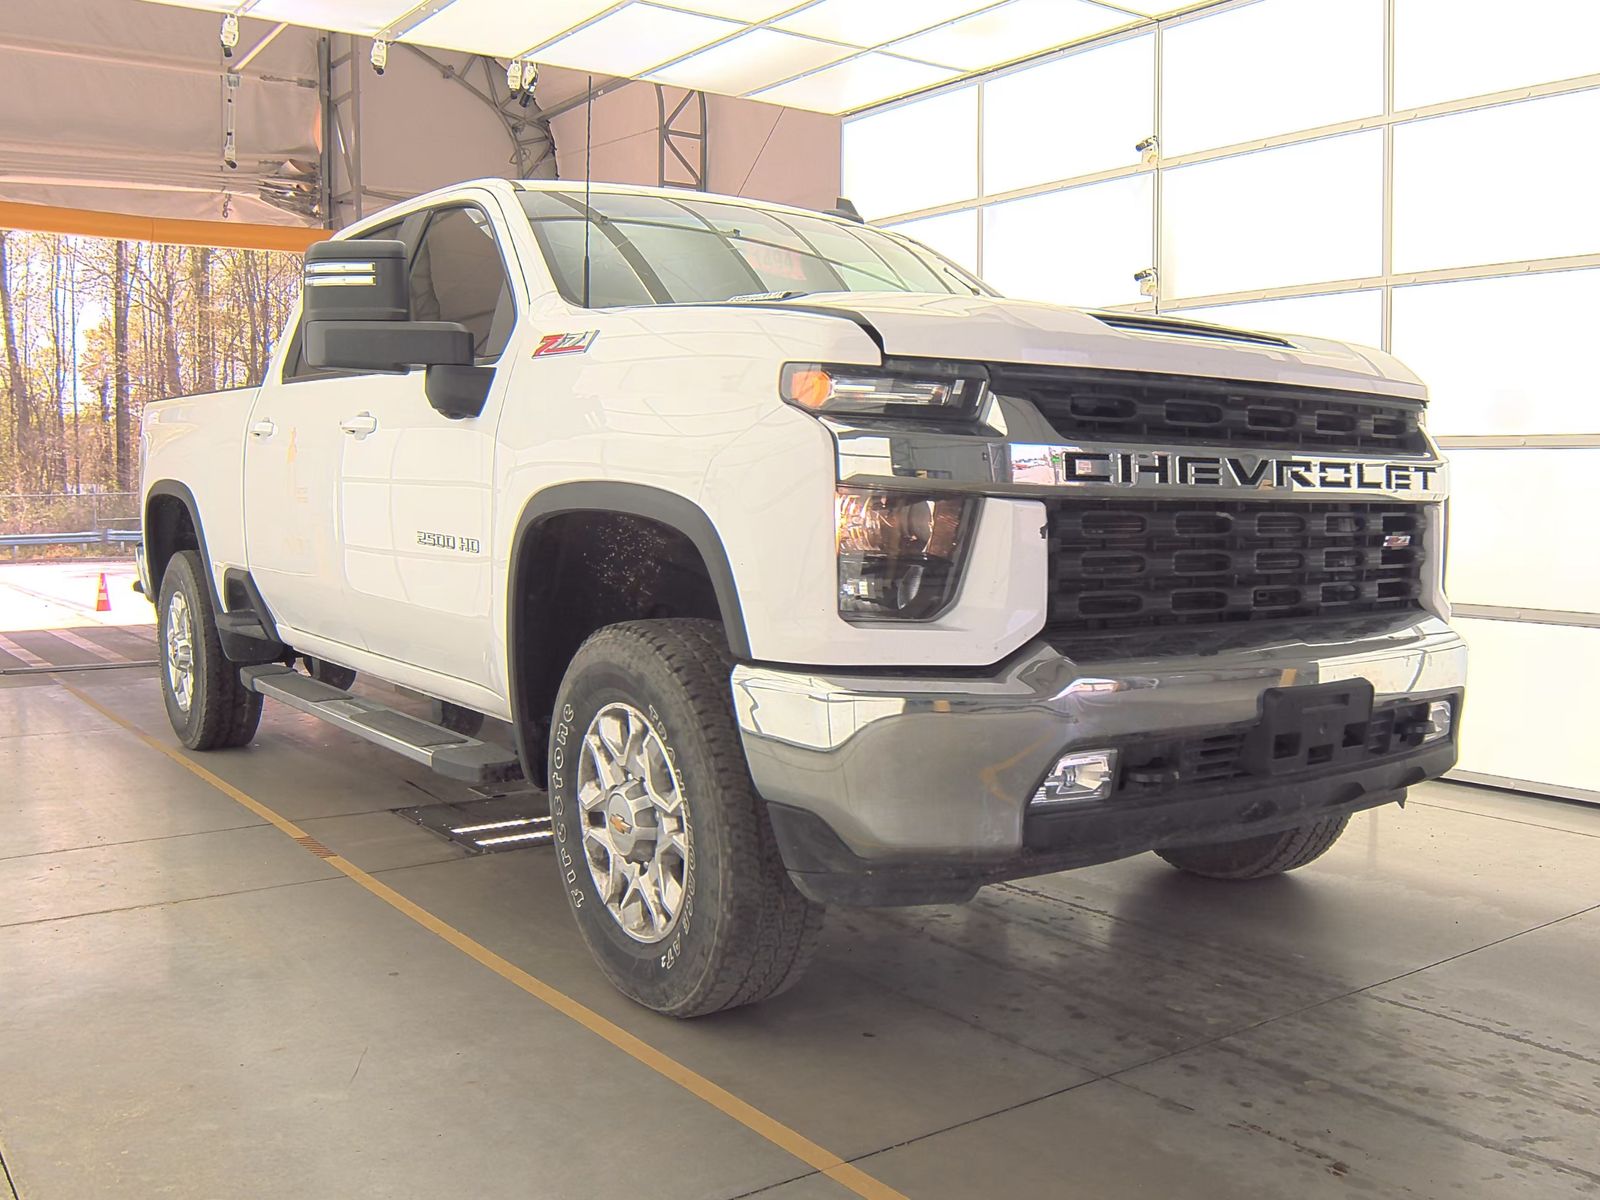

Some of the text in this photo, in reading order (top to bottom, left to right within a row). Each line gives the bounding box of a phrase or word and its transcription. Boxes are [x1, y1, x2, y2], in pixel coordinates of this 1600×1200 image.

[533, 330, 600, 359] Z71
[1064, 452, 1438, 490] CHEVROLET
[417, 531, 480, 553] 2500 HD
